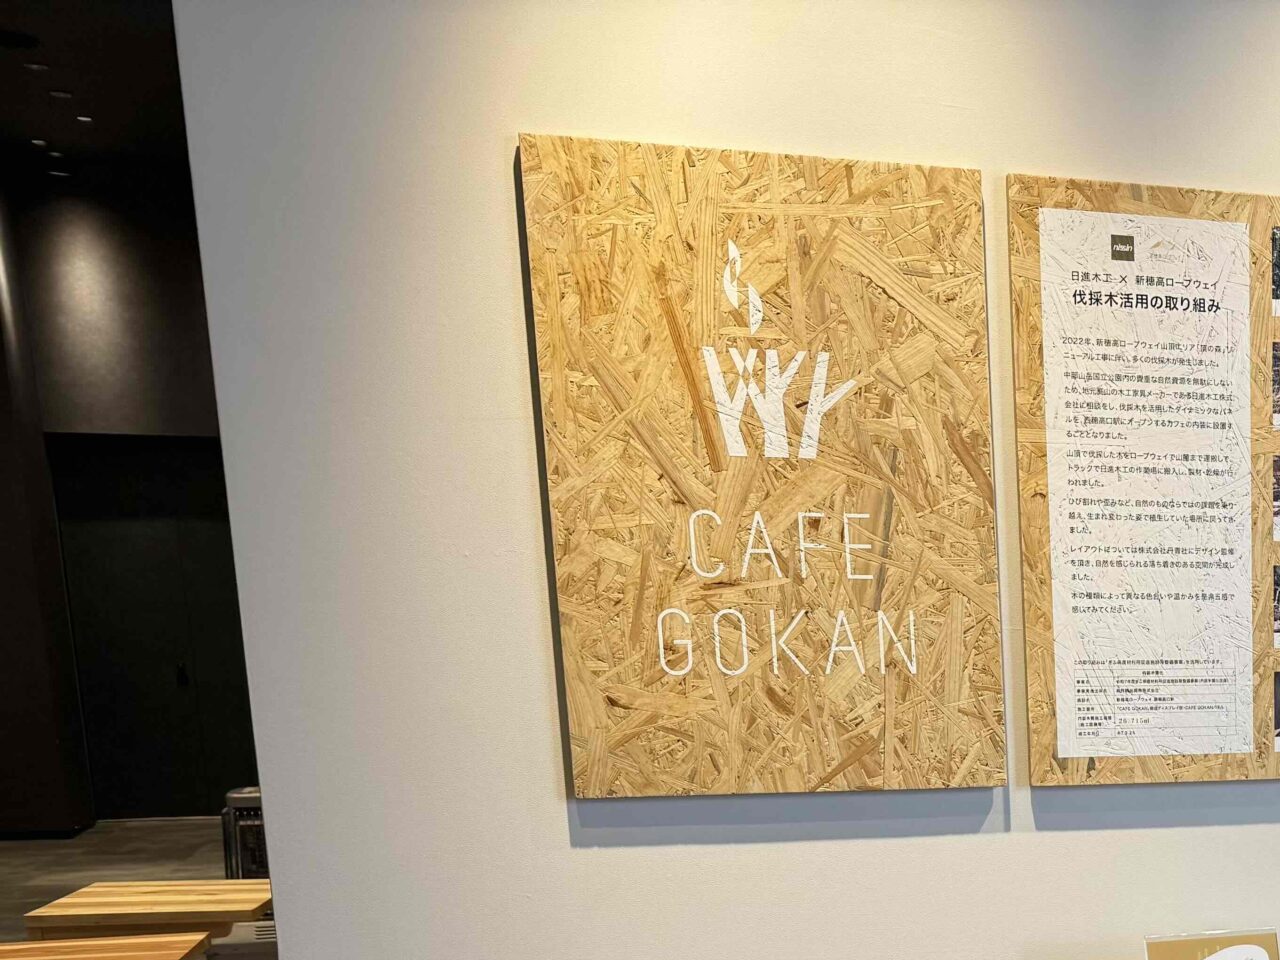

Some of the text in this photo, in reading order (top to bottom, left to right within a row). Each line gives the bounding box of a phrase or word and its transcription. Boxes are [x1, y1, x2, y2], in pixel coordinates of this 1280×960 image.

[1071, 271, 1112, 283] 日進木工
[1135, 275, 1218, 290] 新穂高ロープウェイ
[1073, 290, 1221, 313] 伐採木活用の取り組み
[1068, 479, 1104, 487] われました。
[689, 510, 874, 580] CAFE
[1071, 573, 1093, 581] ました。
[657, 608, 917, 676] GOKAN
